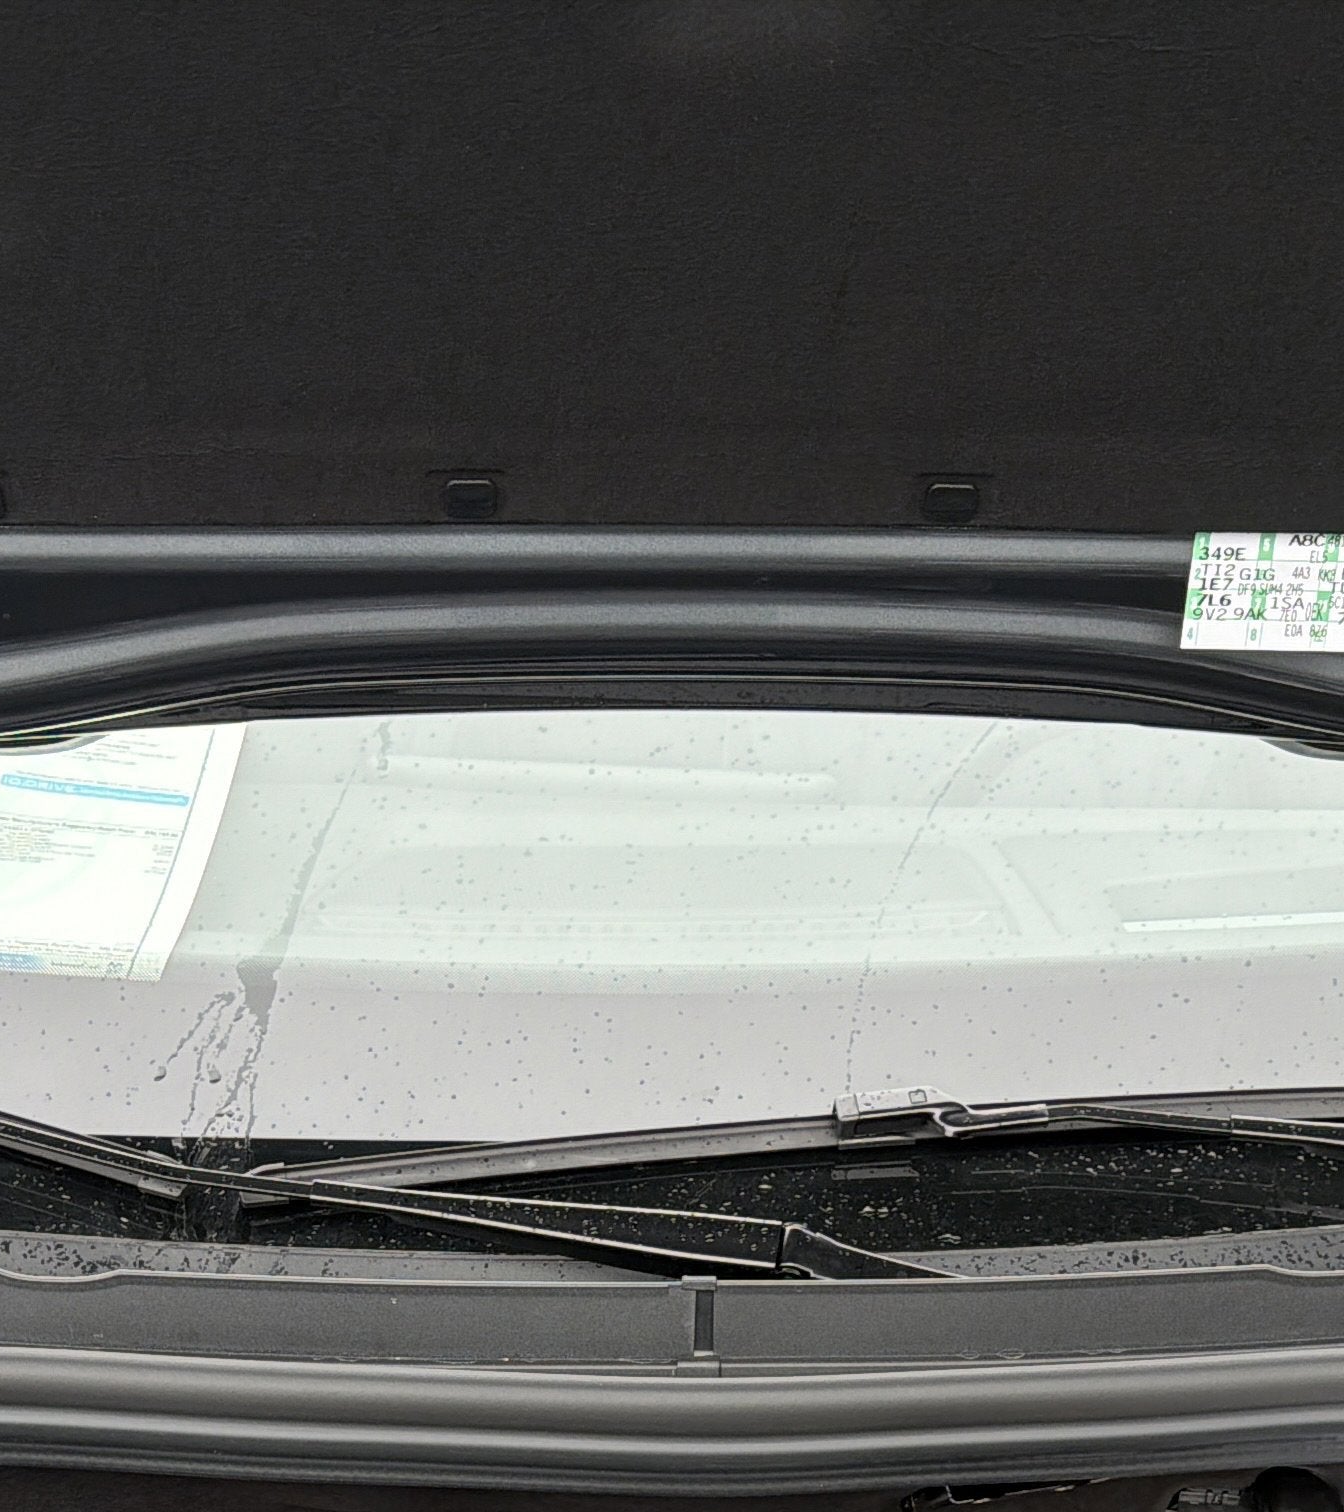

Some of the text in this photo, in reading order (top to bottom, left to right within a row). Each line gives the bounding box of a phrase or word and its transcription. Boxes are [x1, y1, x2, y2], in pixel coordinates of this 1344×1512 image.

[1199, 547, 1247, 561] 349E
[1292, 566, 1311, 579] 4A3
[1199, 577, 1234, 591] 1E7
[1196, 594, 1232, 607] 7L6
[1192, 607, 1227, 621] 9V2
[1233, 607, 1267, 620] 9AK
